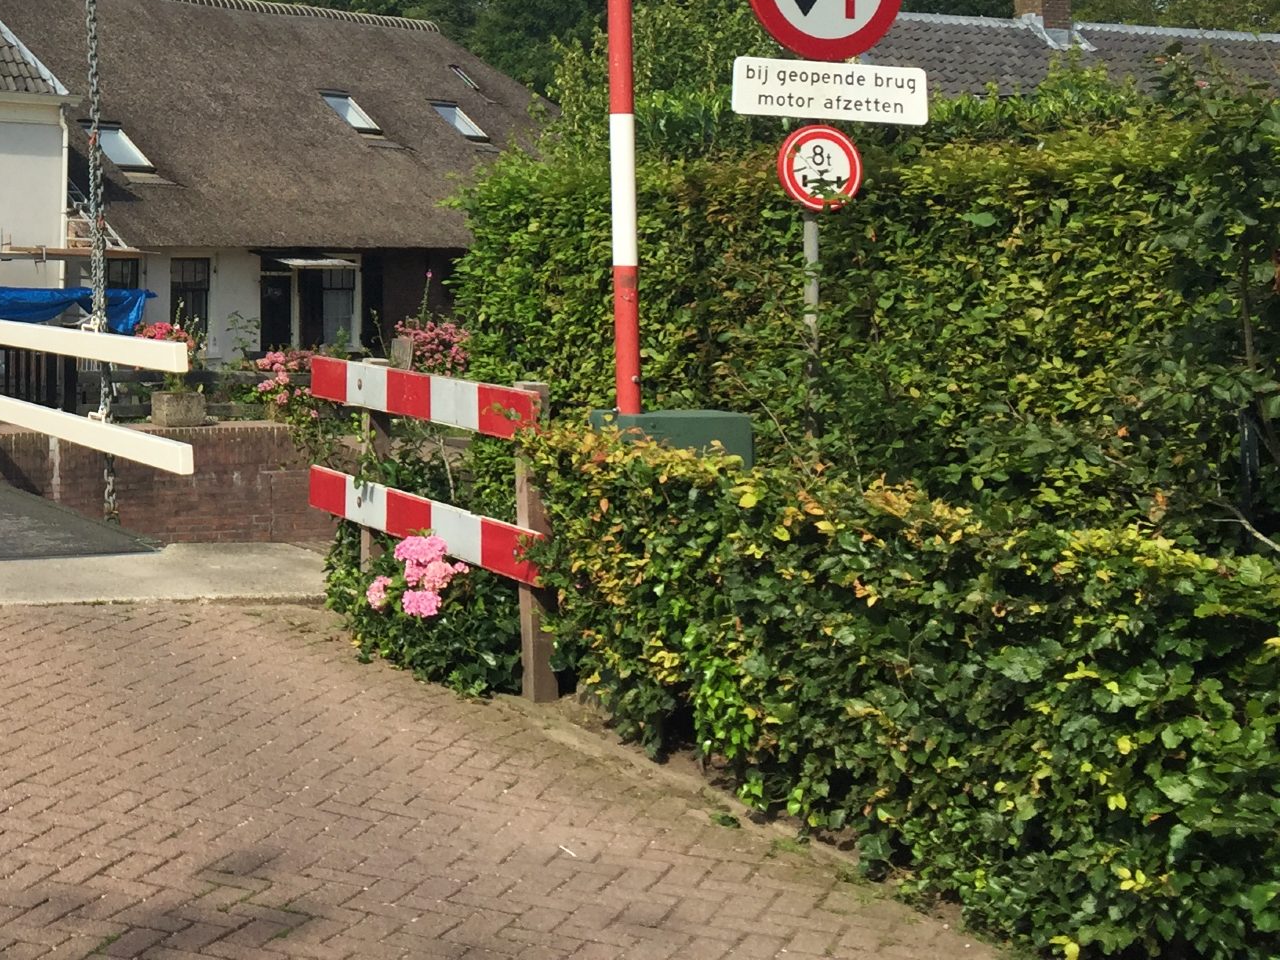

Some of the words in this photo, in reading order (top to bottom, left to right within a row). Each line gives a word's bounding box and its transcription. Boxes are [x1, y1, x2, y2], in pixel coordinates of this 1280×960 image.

[746, 65, 769, 85] bij
[777, 69, 866, 87] geopende
[874, 73, 916, 94] brug
[757, 93, 815, 108] motor
[823, 96, 904, 114] afzetten
